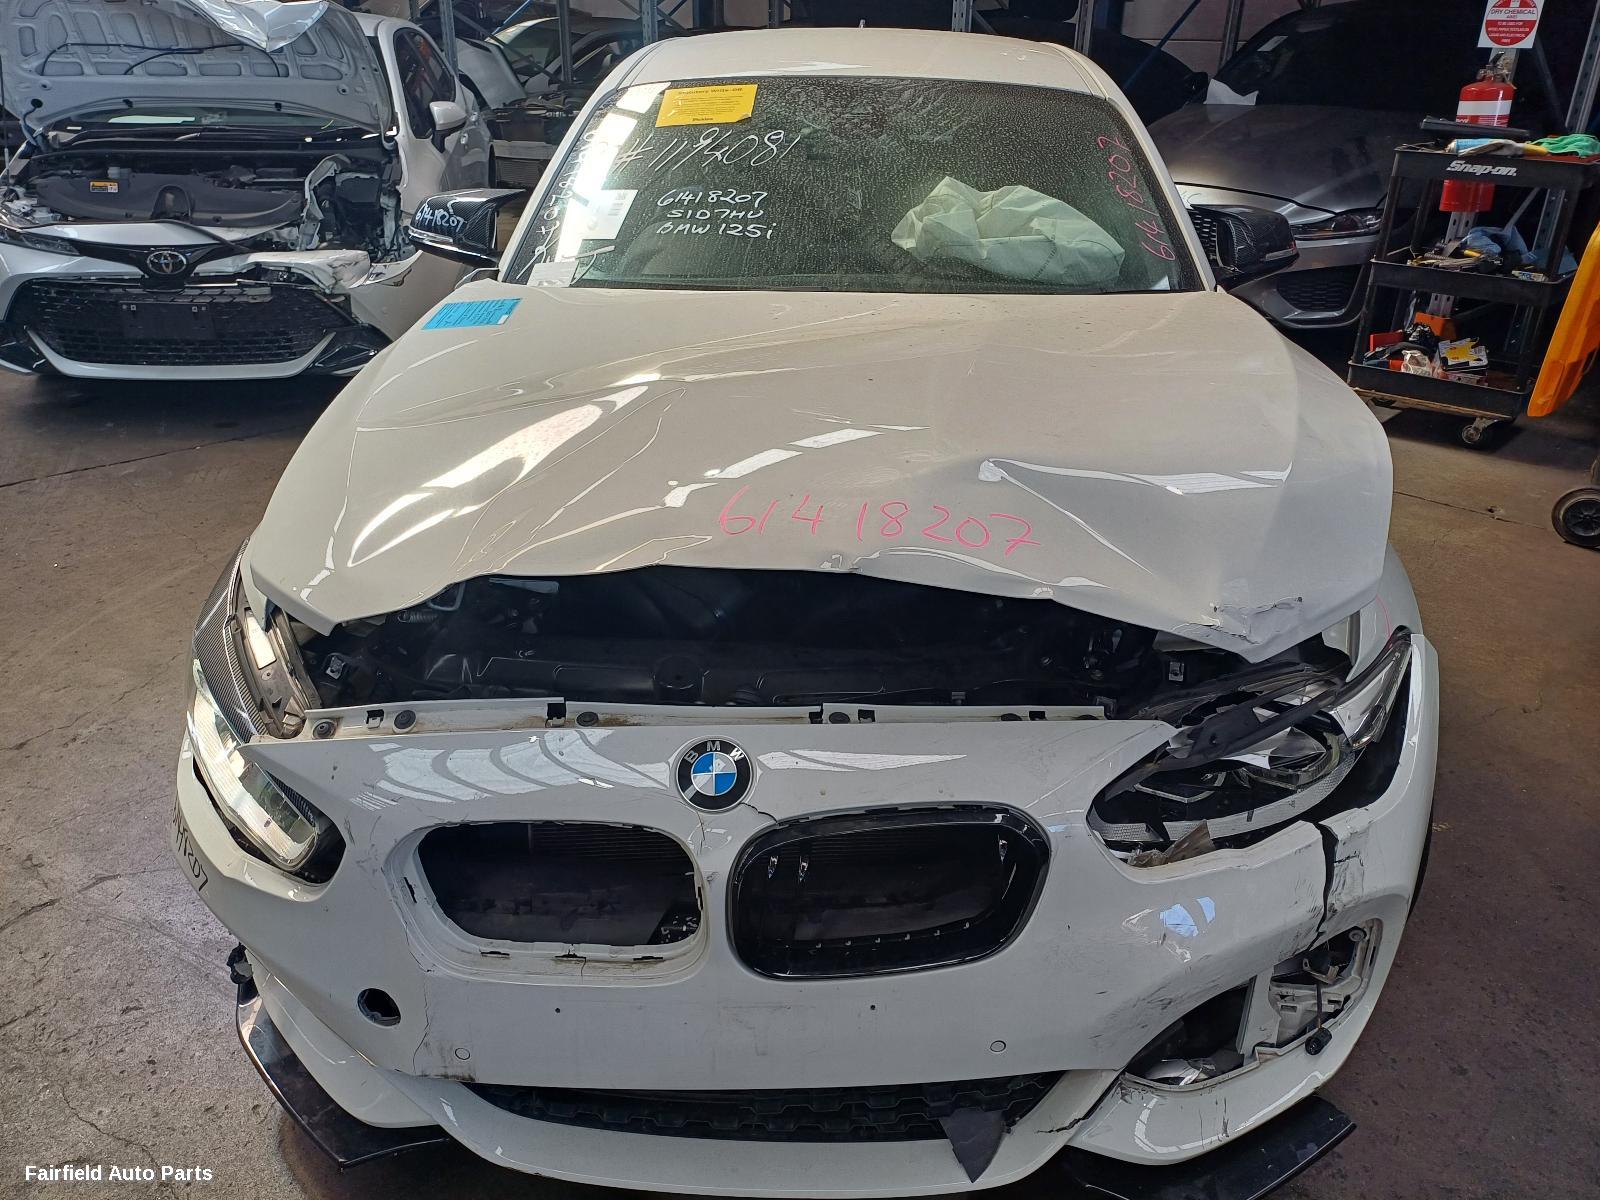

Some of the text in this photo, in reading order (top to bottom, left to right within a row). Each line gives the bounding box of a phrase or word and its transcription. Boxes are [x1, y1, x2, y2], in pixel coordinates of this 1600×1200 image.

[656, 189, 768, 207] 61418207
[656, 222, 777, 239] BMW 125i
[718, 484, 1041, 556] 61418207
[684, 740, 745, 764] BMW
